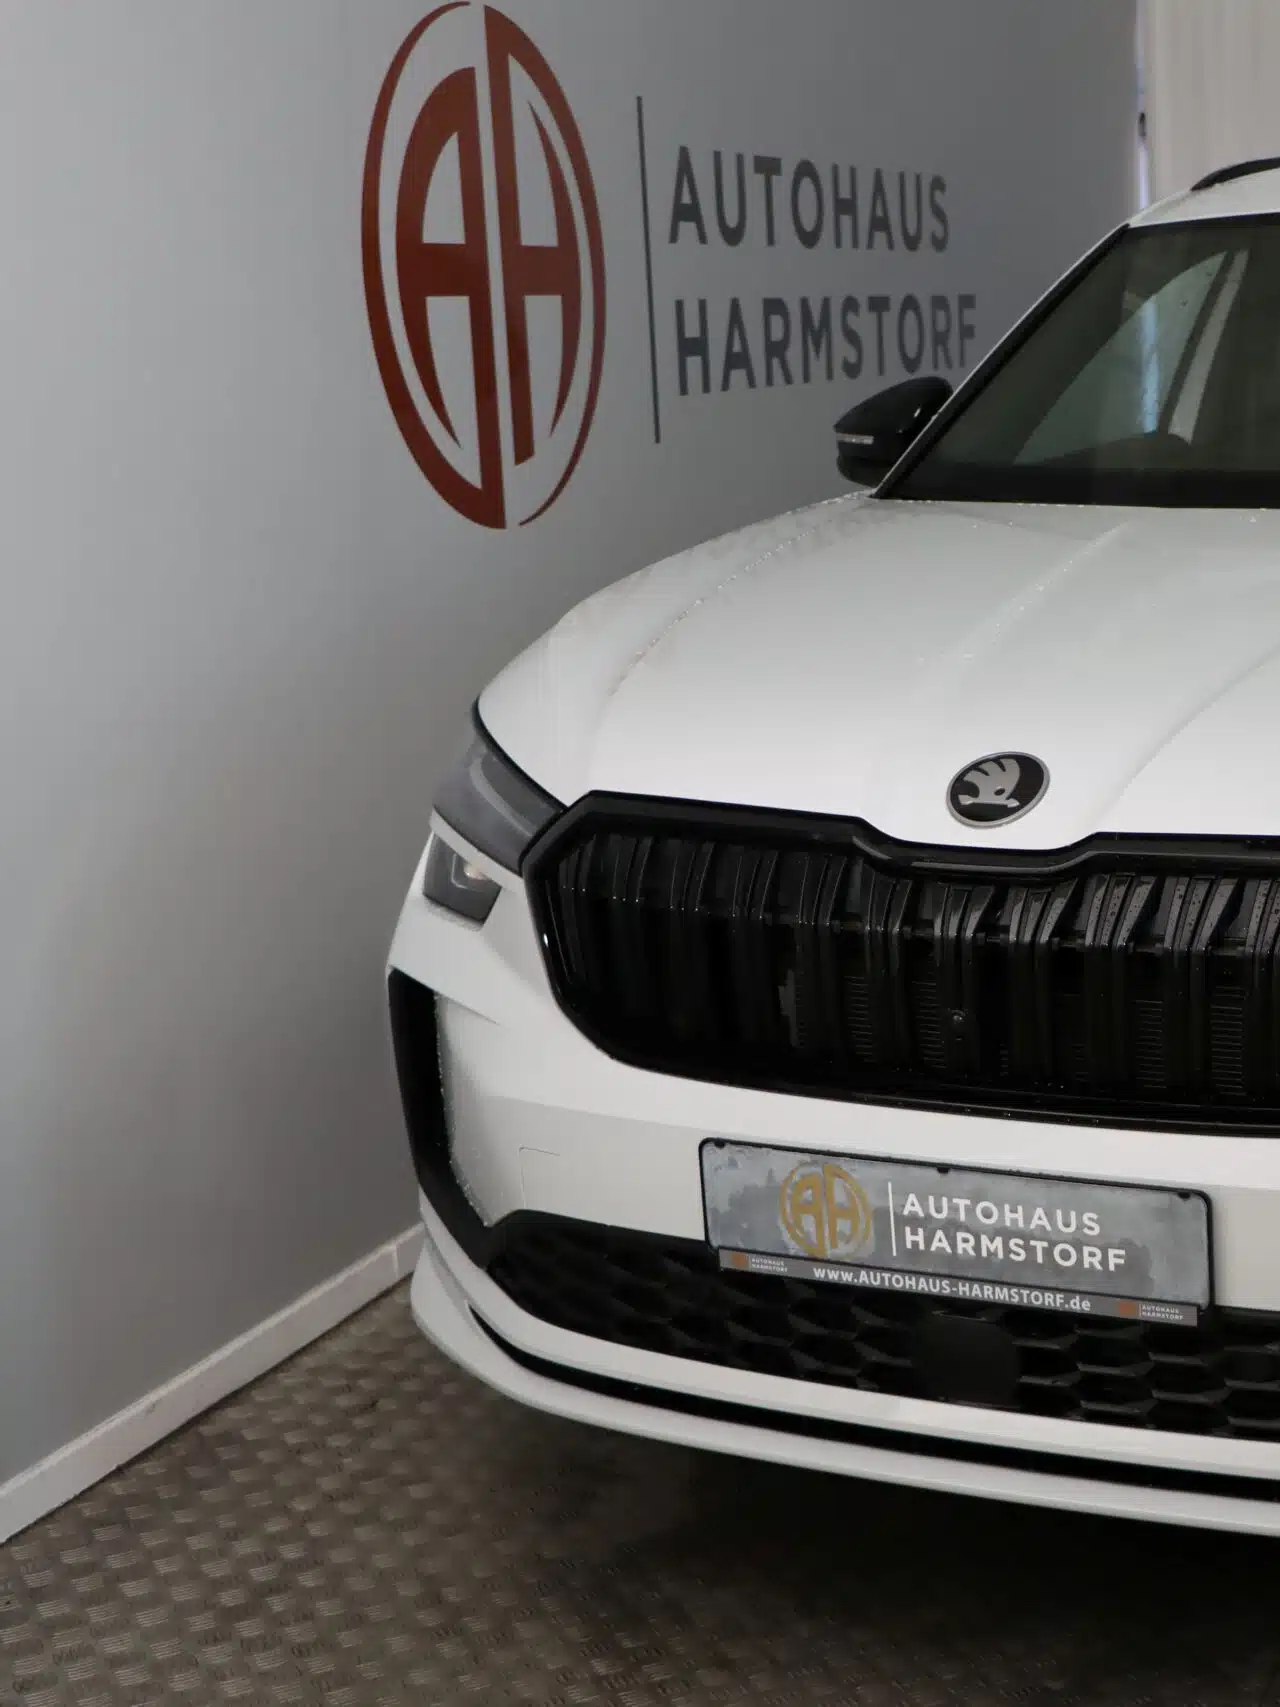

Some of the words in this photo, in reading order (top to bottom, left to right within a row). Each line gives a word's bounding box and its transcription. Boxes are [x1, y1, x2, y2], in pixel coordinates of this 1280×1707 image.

[668, 145, 951, 253] AUTOHAUS
[675, 294, 977, 397] HARMSTORF
[903, 1193, 1101, 1234] AUTOHAUS
[904, 1227, 1127, 1272] HARMSTORF
